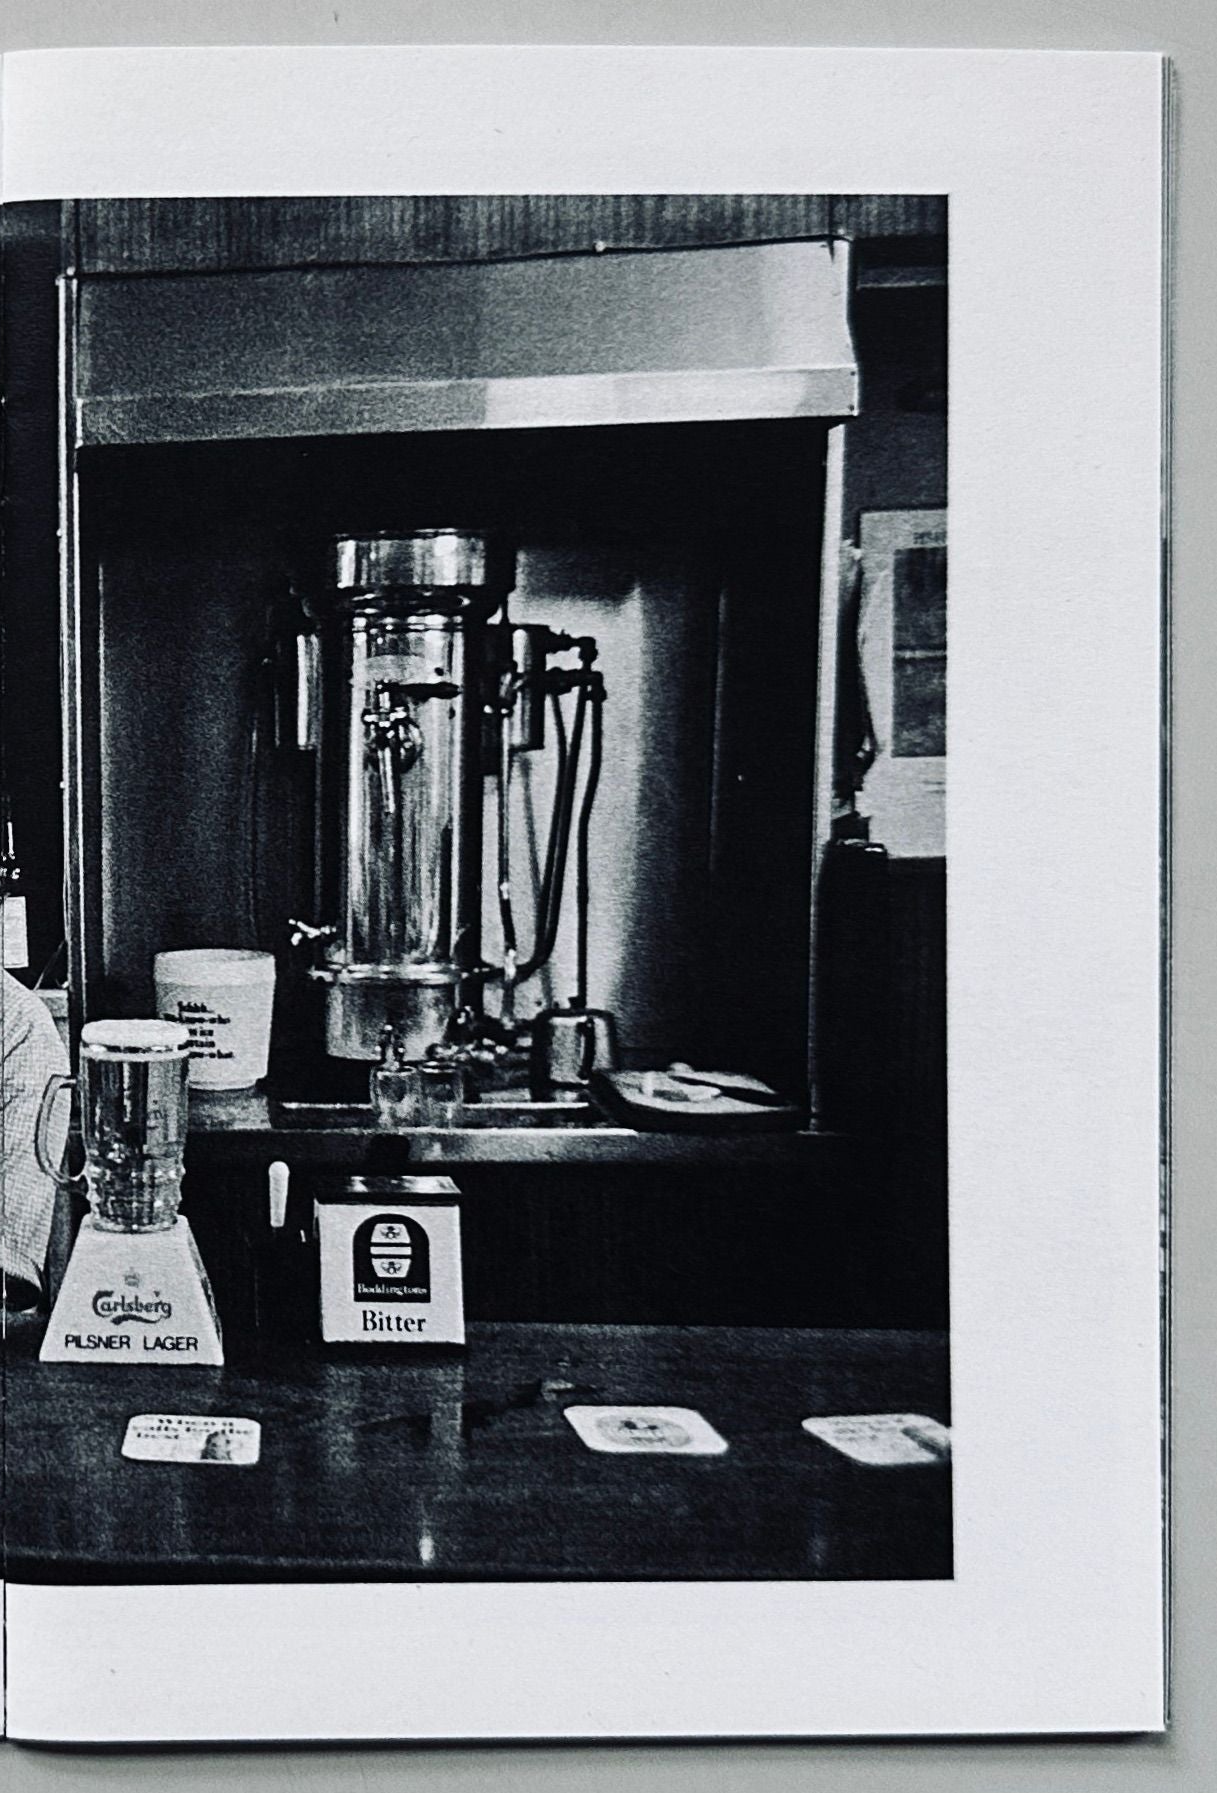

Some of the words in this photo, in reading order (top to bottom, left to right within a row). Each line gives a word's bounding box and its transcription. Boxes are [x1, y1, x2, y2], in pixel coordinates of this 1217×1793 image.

[92, 1290, 172, 1322] Carlsberg
[362, 1310, 426, 1332] Bitter
[64, 1334, 131, 1349] PILSNER
[143, 1335, 199, 1351] LAGER
